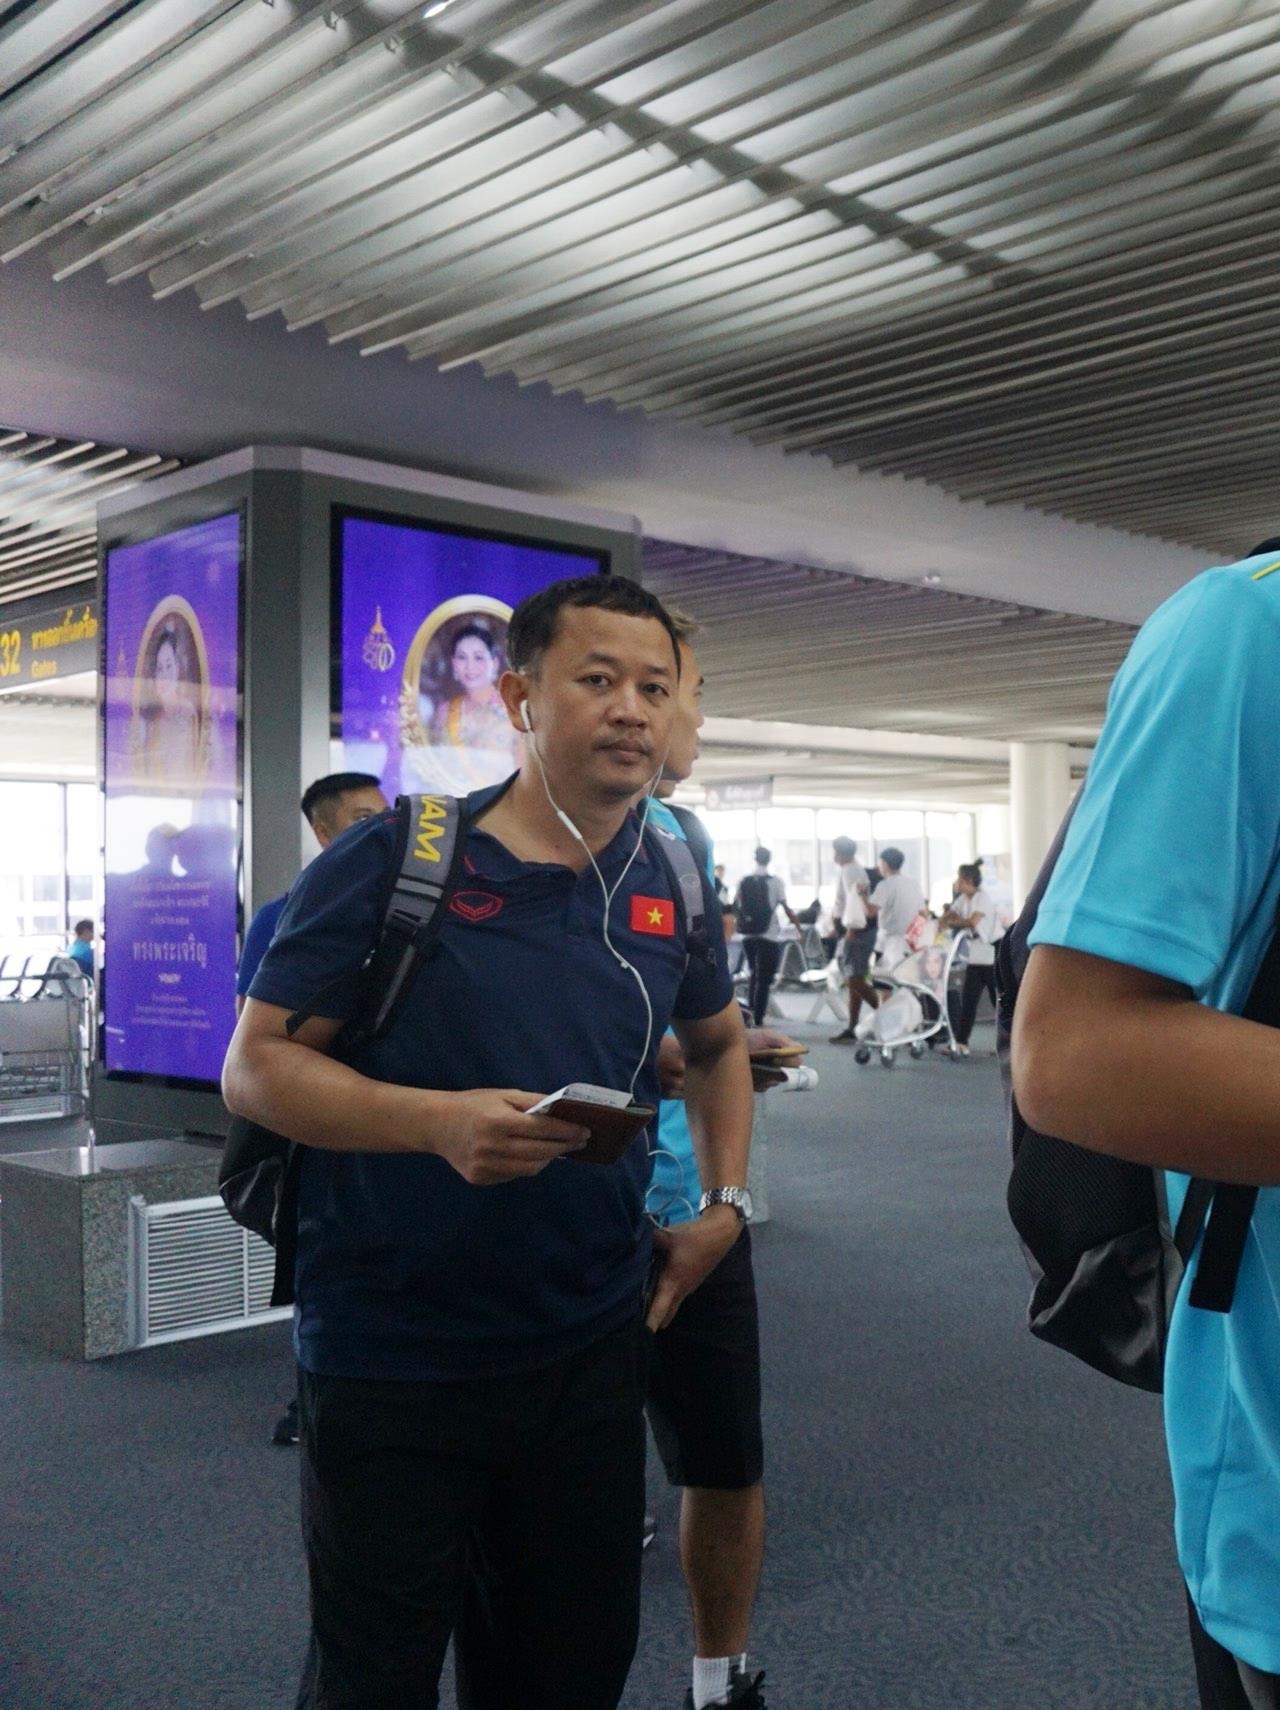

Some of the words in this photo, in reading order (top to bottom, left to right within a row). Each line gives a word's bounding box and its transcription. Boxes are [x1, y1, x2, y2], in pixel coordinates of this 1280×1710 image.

[0, 630, 21, 676] 32
[132, 932, 208, 969] ทรงพระเจริญ
